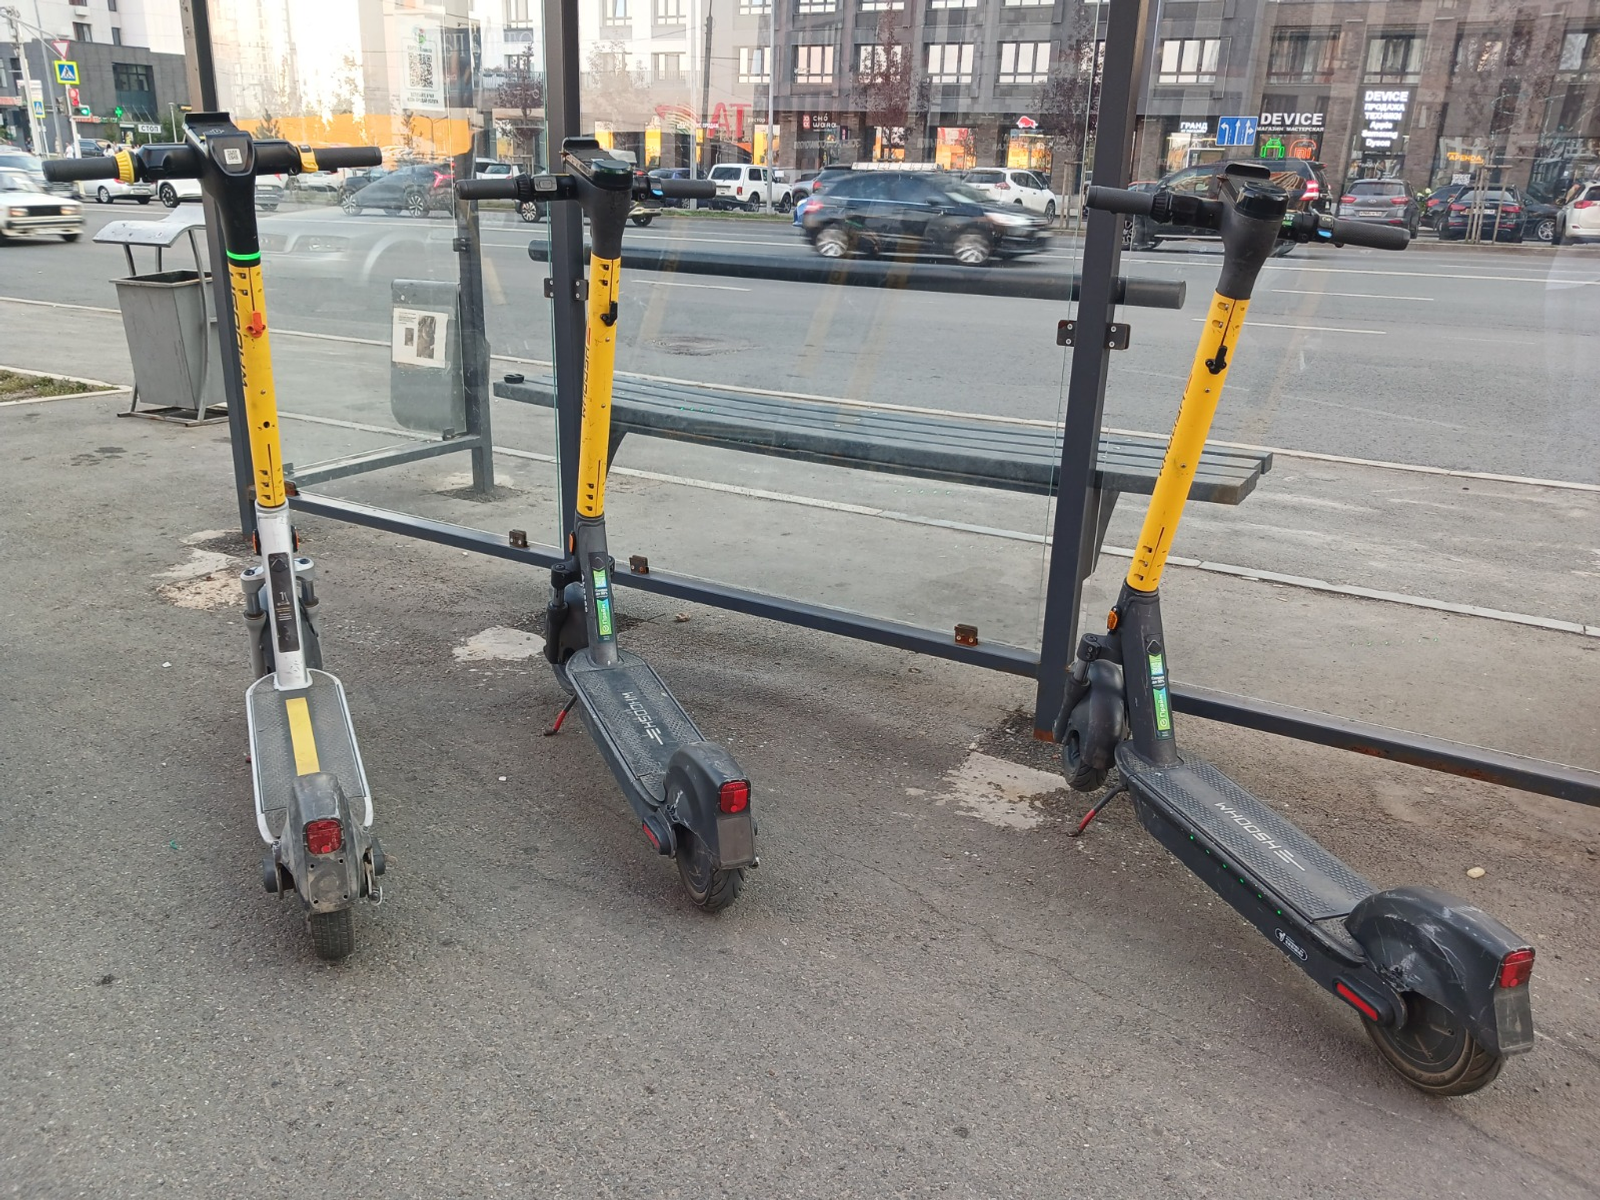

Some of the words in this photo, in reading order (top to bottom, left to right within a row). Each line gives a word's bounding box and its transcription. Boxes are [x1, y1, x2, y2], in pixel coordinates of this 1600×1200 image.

[1364, 91, 1409, 102] DEVICE
[1260, 112, 1324, 126] DEVICE
[1180, 122, 1208, 132] ГРАНД
[1369, 121, 1393, 130] Apple
[1361, 130, 1399, 140] Samsung
[1365, 139, 1391, 148] Dyson
[621, 691, 657, 729] WHOOSH
[1214, 802, 1282, 850] WHOOSH
